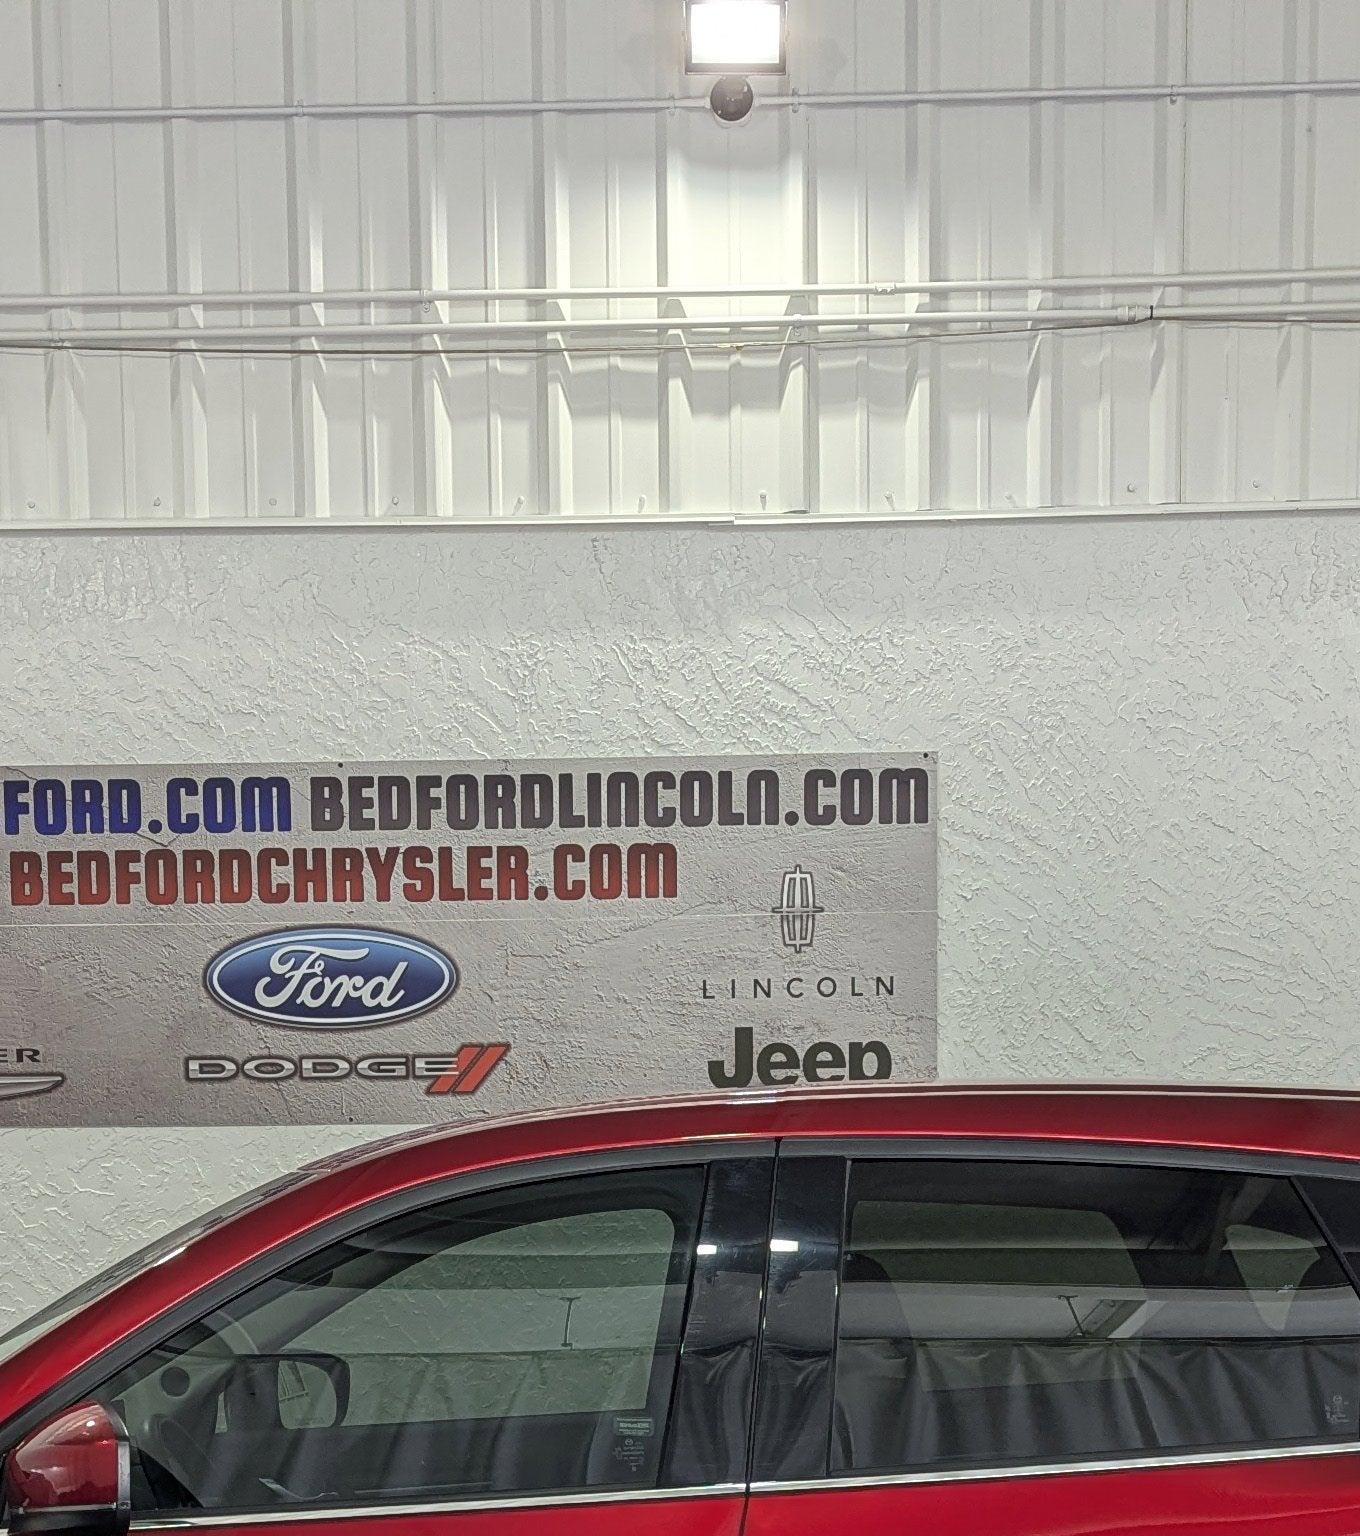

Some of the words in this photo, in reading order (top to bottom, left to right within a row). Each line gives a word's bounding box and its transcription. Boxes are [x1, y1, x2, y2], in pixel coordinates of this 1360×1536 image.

[310, 767, 930, 831] BEDFORDLINCOLN.COM
[10, 842, 678, 906] BEDFORDCHRYSLER.COM
[254, 943, 410, 1008] Ford
[702, 976, 896, 1000] LINCOLN
[187, 1055, 461, 1080] DODGE
[707, 1026, 892, 1088] Jeep
